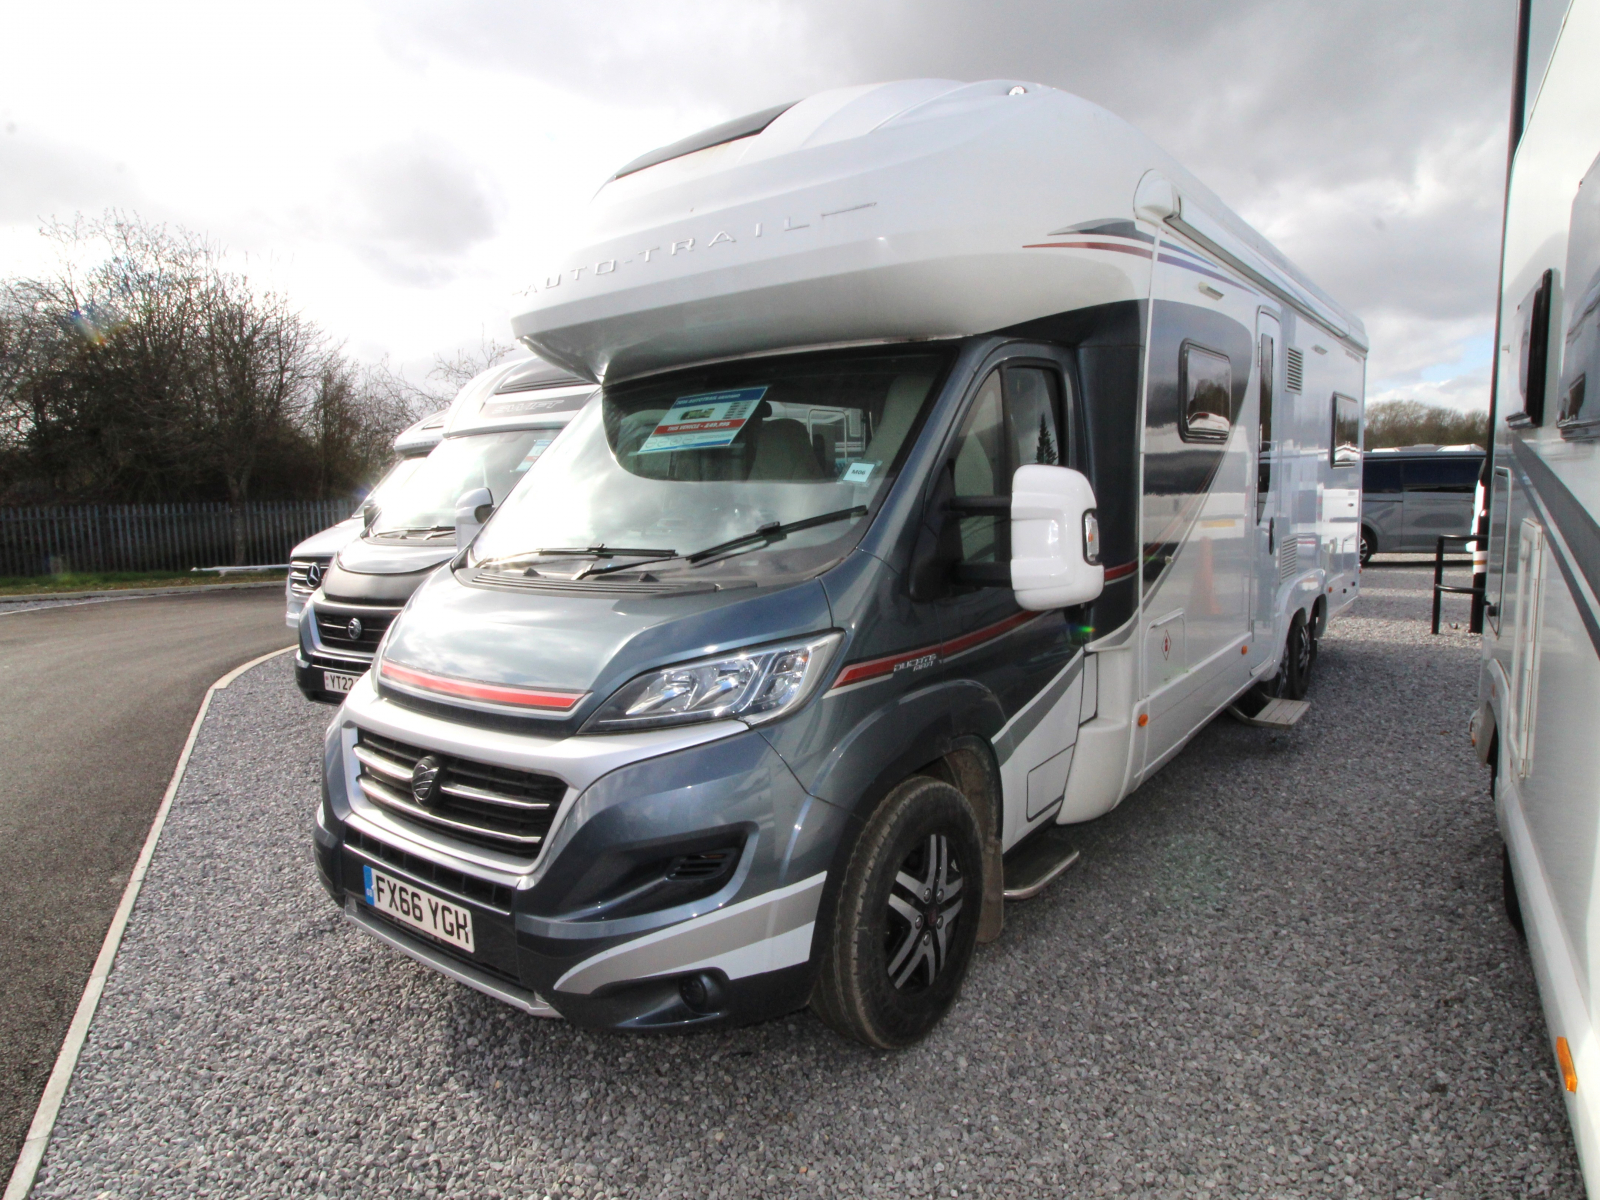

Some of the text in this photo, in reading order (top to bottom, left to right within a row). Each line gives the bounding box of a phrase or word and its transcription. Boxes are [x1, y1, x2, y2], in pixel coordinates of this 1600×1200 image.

[523, 215, 810, 297] AUTO-TRAIL
[492, 399, 565, 414] SWIFT
[680, 423, 701, 431] VEHICLE
[375, 874, 424, 923] FX66
[427, 897, 470, 944] YGH
